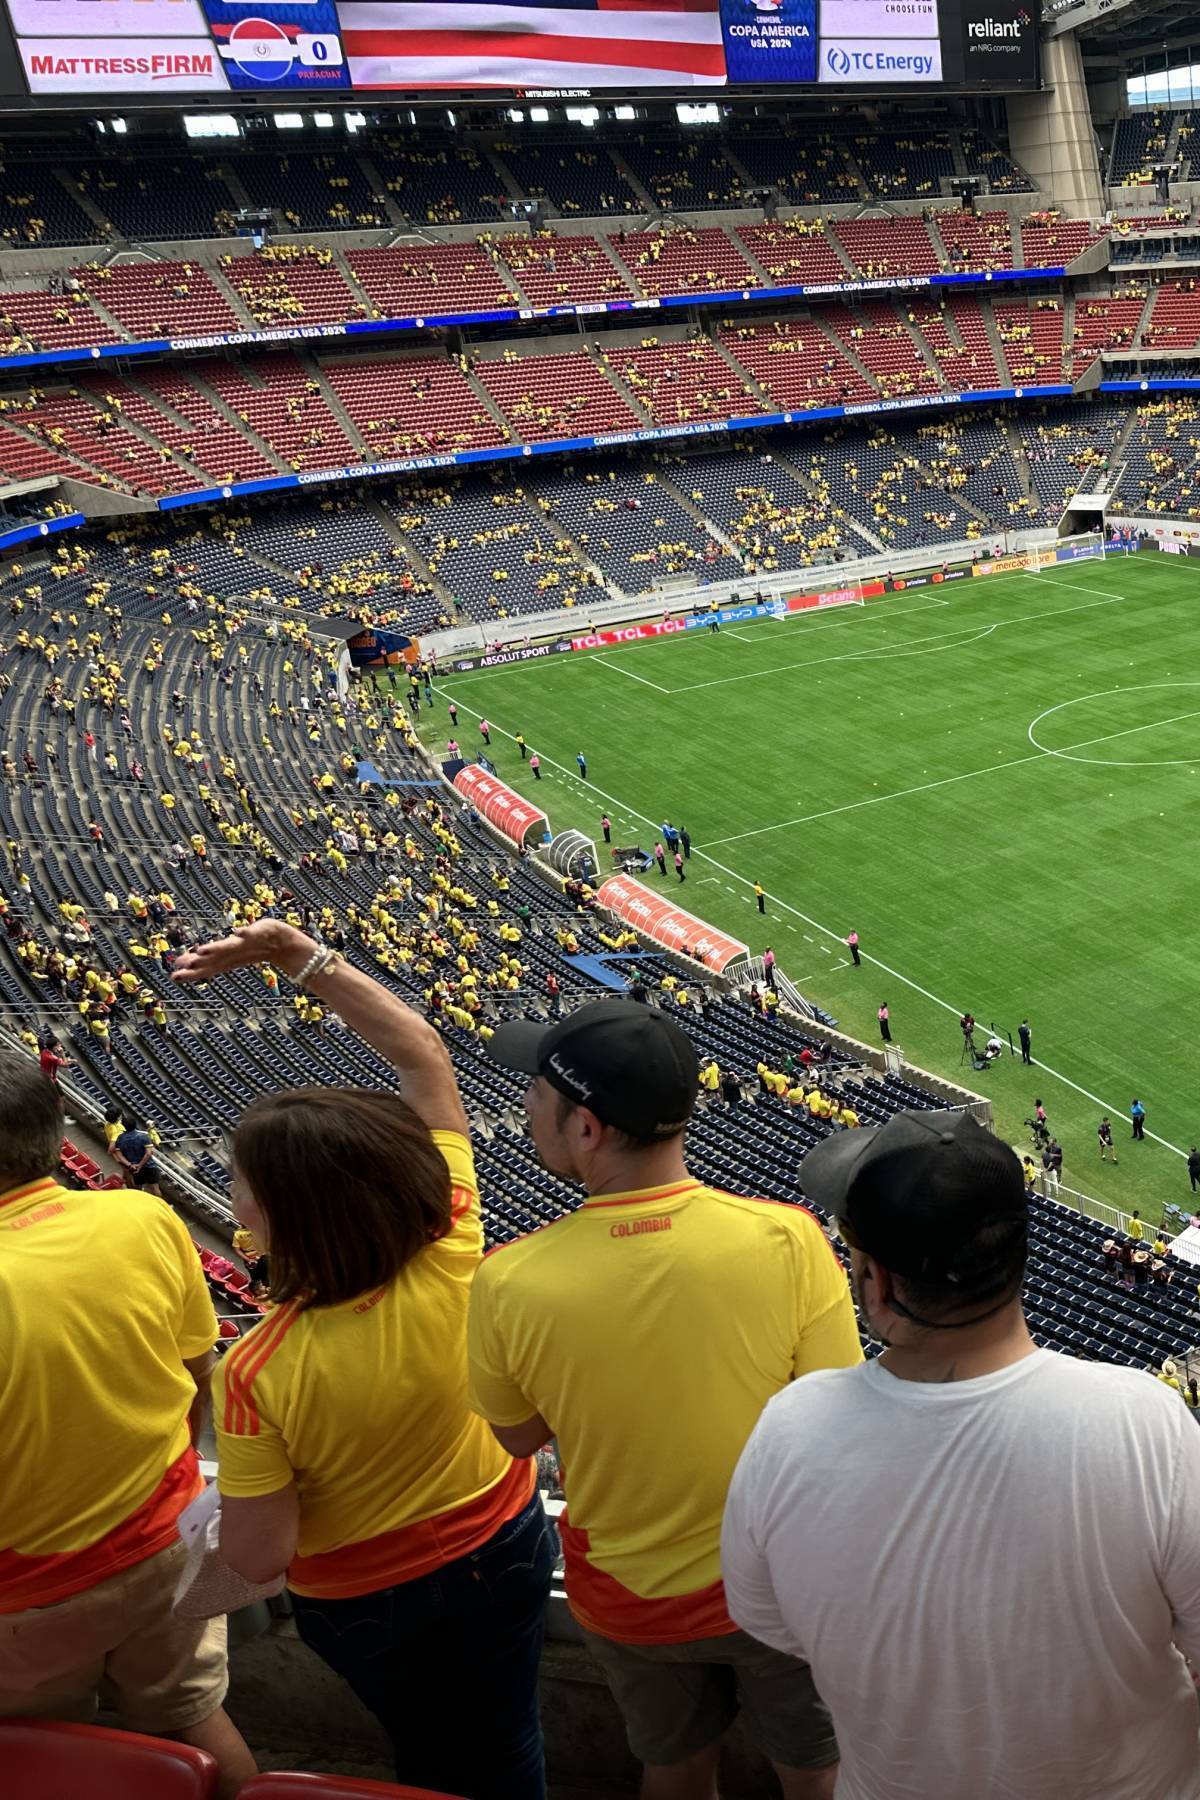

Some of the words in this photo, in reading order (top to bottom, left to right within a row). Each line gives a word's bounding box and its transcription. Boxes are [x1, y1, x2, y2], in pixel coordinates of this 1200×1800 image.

[885, 5, 916, 14] CHOOSE
[918, 5, 933, 13] FUN
[729, 25, 759, 37] COPA
[760, 25, 810, 37] AMERICA
[968, 18, 1021, 37] reliant
[312, 40, 328, 61] 0
[750, 39, 768, 48] USA
[770, 38, 792, 48] 2024
[977, 43, 993, 52] NRG
[992, 44, 1021, 54] company
[851, 53, 874, 70] TC
[875, 53, 933, 74] Energy
[525, 90, 560, 98] MITSUBISHI
[560, 89, 591, 97] ELECTRIC
[802, 284, 844, 294] CONMEBOL
[843, 282, 861, 291] COPA
[860, 279, 897, 289] AMERICA
[897, 278, 912, 287] USA
[912, 277, 931, 285] 2024
[170, 335, 228, 350] CONMEBOL
[227, 333, 255, 345] COPA
[255, 329, 300, 342] AMERICA
[301, 327, 322, 338] USA
[322, 326, 347, 336] 2024
[843, 403, 882, 415] CONMEBOL
[882, 401, 901, 410] COPA
[900, 397, 930, 408] AMERICA
[930, 396, 943, 405] USA
[944, 394, 961, 403] 2024
[593, 432, 640, 446] CONMEBOL
[639, 430, 661, 440] COPA
[660, 425, 694, 438] AMERICA
[694, 424, 709, 433] USA
[710, 422, 729, 431] 2024
[297, 469, 349, 484] CONMEBOL
[349, 466, 376, 477] COPA
[375, 460, 416, 474] AMERICA
[416, 458, 435, 468] USA
[435, 455, 457, 467] 2024
[995, 556, 1032, 571] mercado
[686, 615, 718, 627] BYD
[722, 609, 753, 621] BYD
[613, 627, 647, 642] TCL
[652, 619, 686, 635] TCL
[573, 635, 608, 650] TCL
[480, 650, 523, 667] ABSOLUT
[521, 645, 551, 659] SPORT
[562, 1068, 593, 1101] Lucky
[610, 1216, 672, 1238] COLOMBIA
